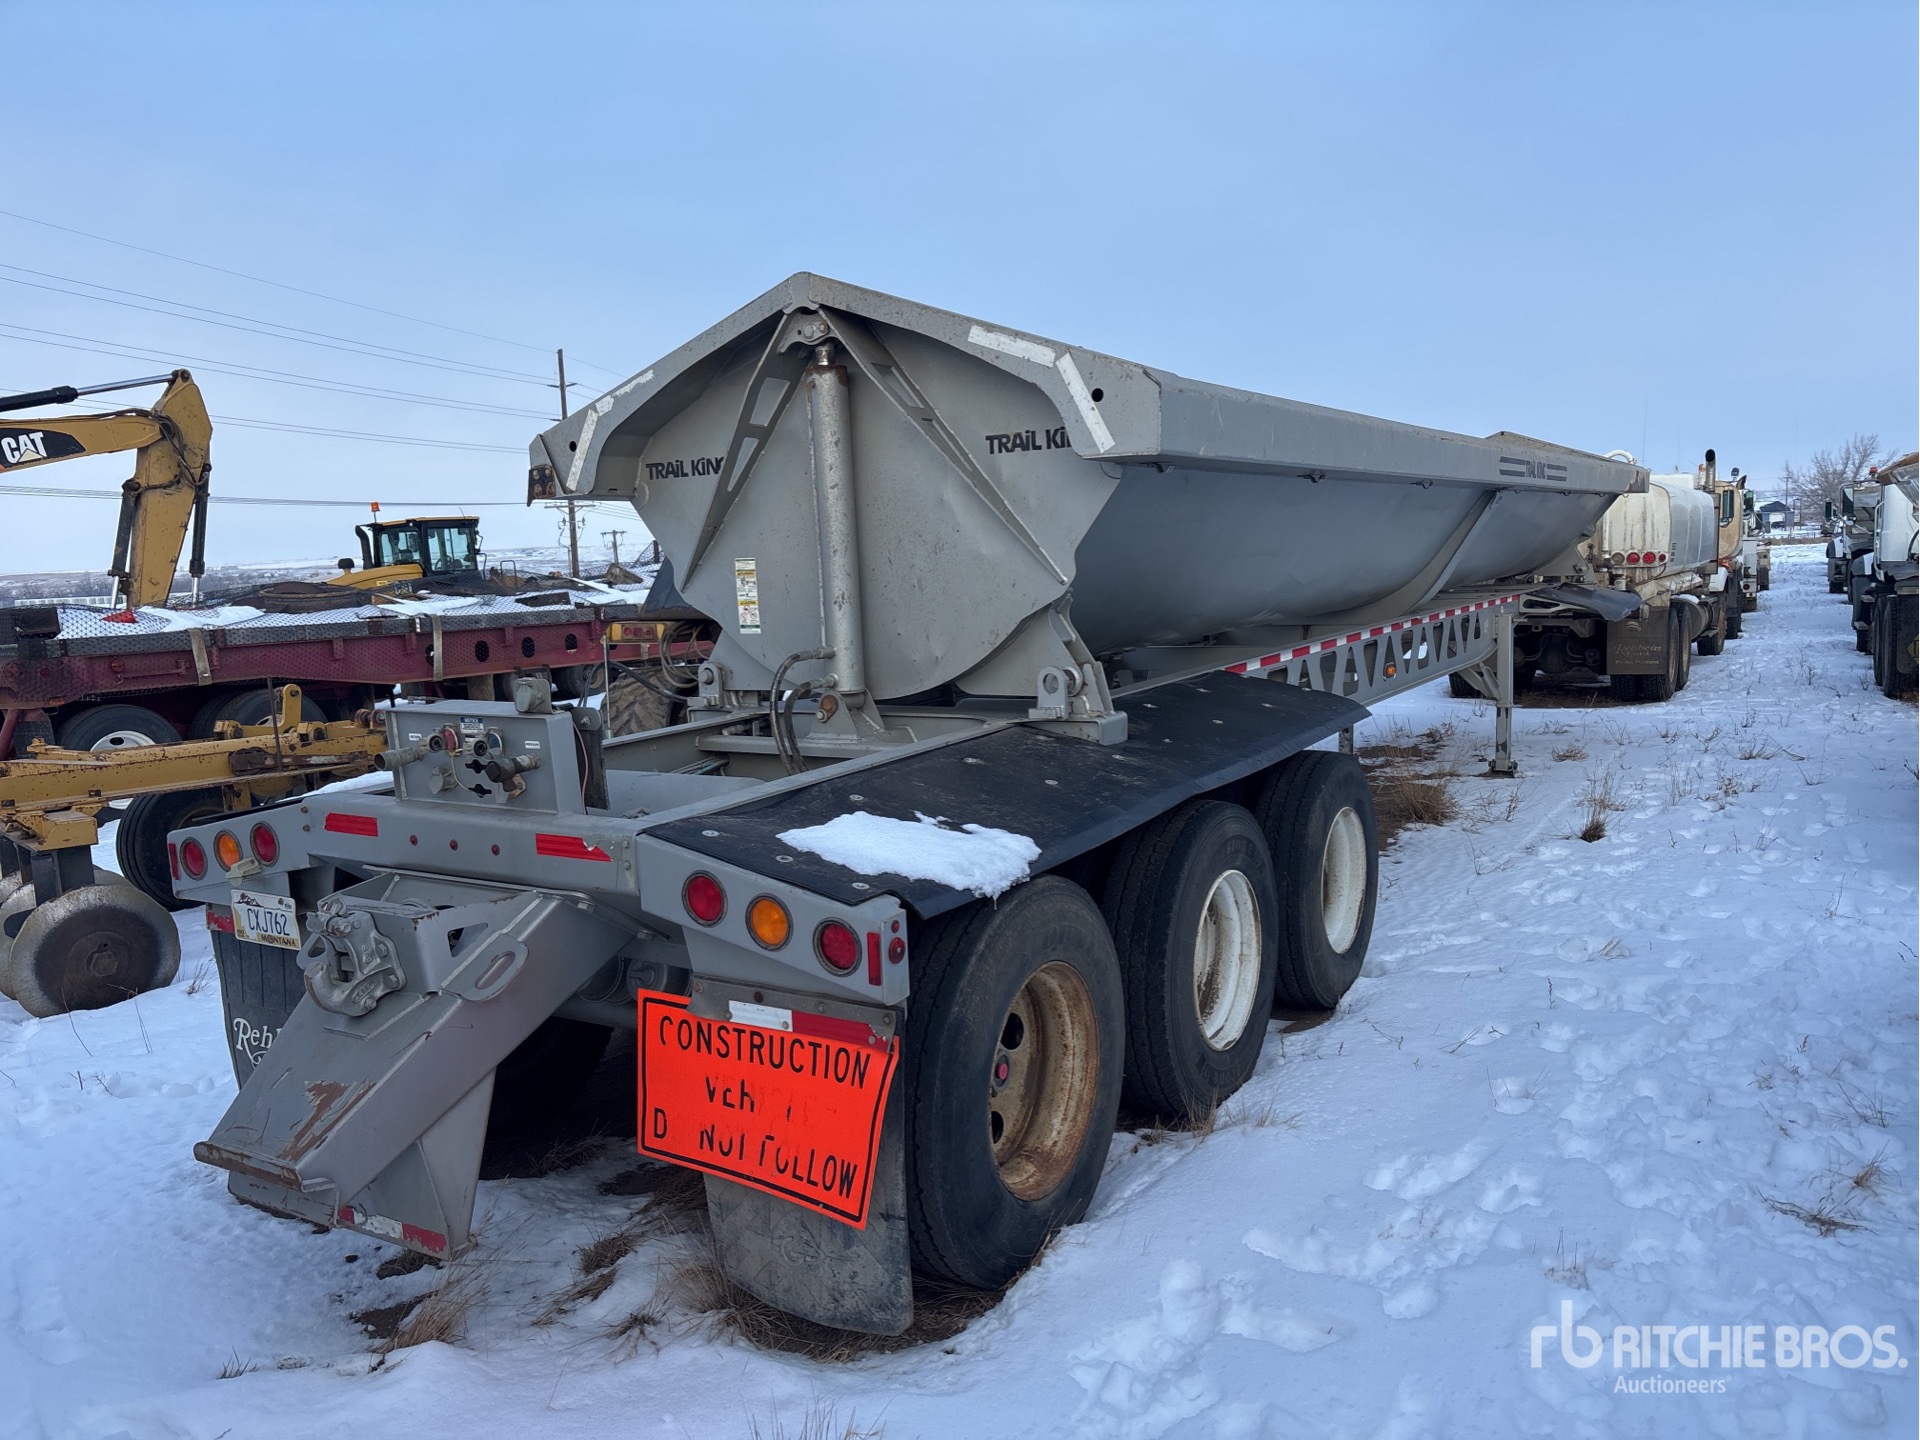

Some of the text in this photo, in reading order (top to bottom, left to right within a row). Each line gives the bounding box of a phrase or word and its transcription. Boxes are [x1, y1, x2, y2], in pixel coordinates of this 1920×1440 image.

[1, 431, 48, 464] CAT
[247, 908, 291, 936] CXJ762
[261, 934, 297, 948] MONTANA
[659, 1015, 872, 1089] CONSTRUCTION
